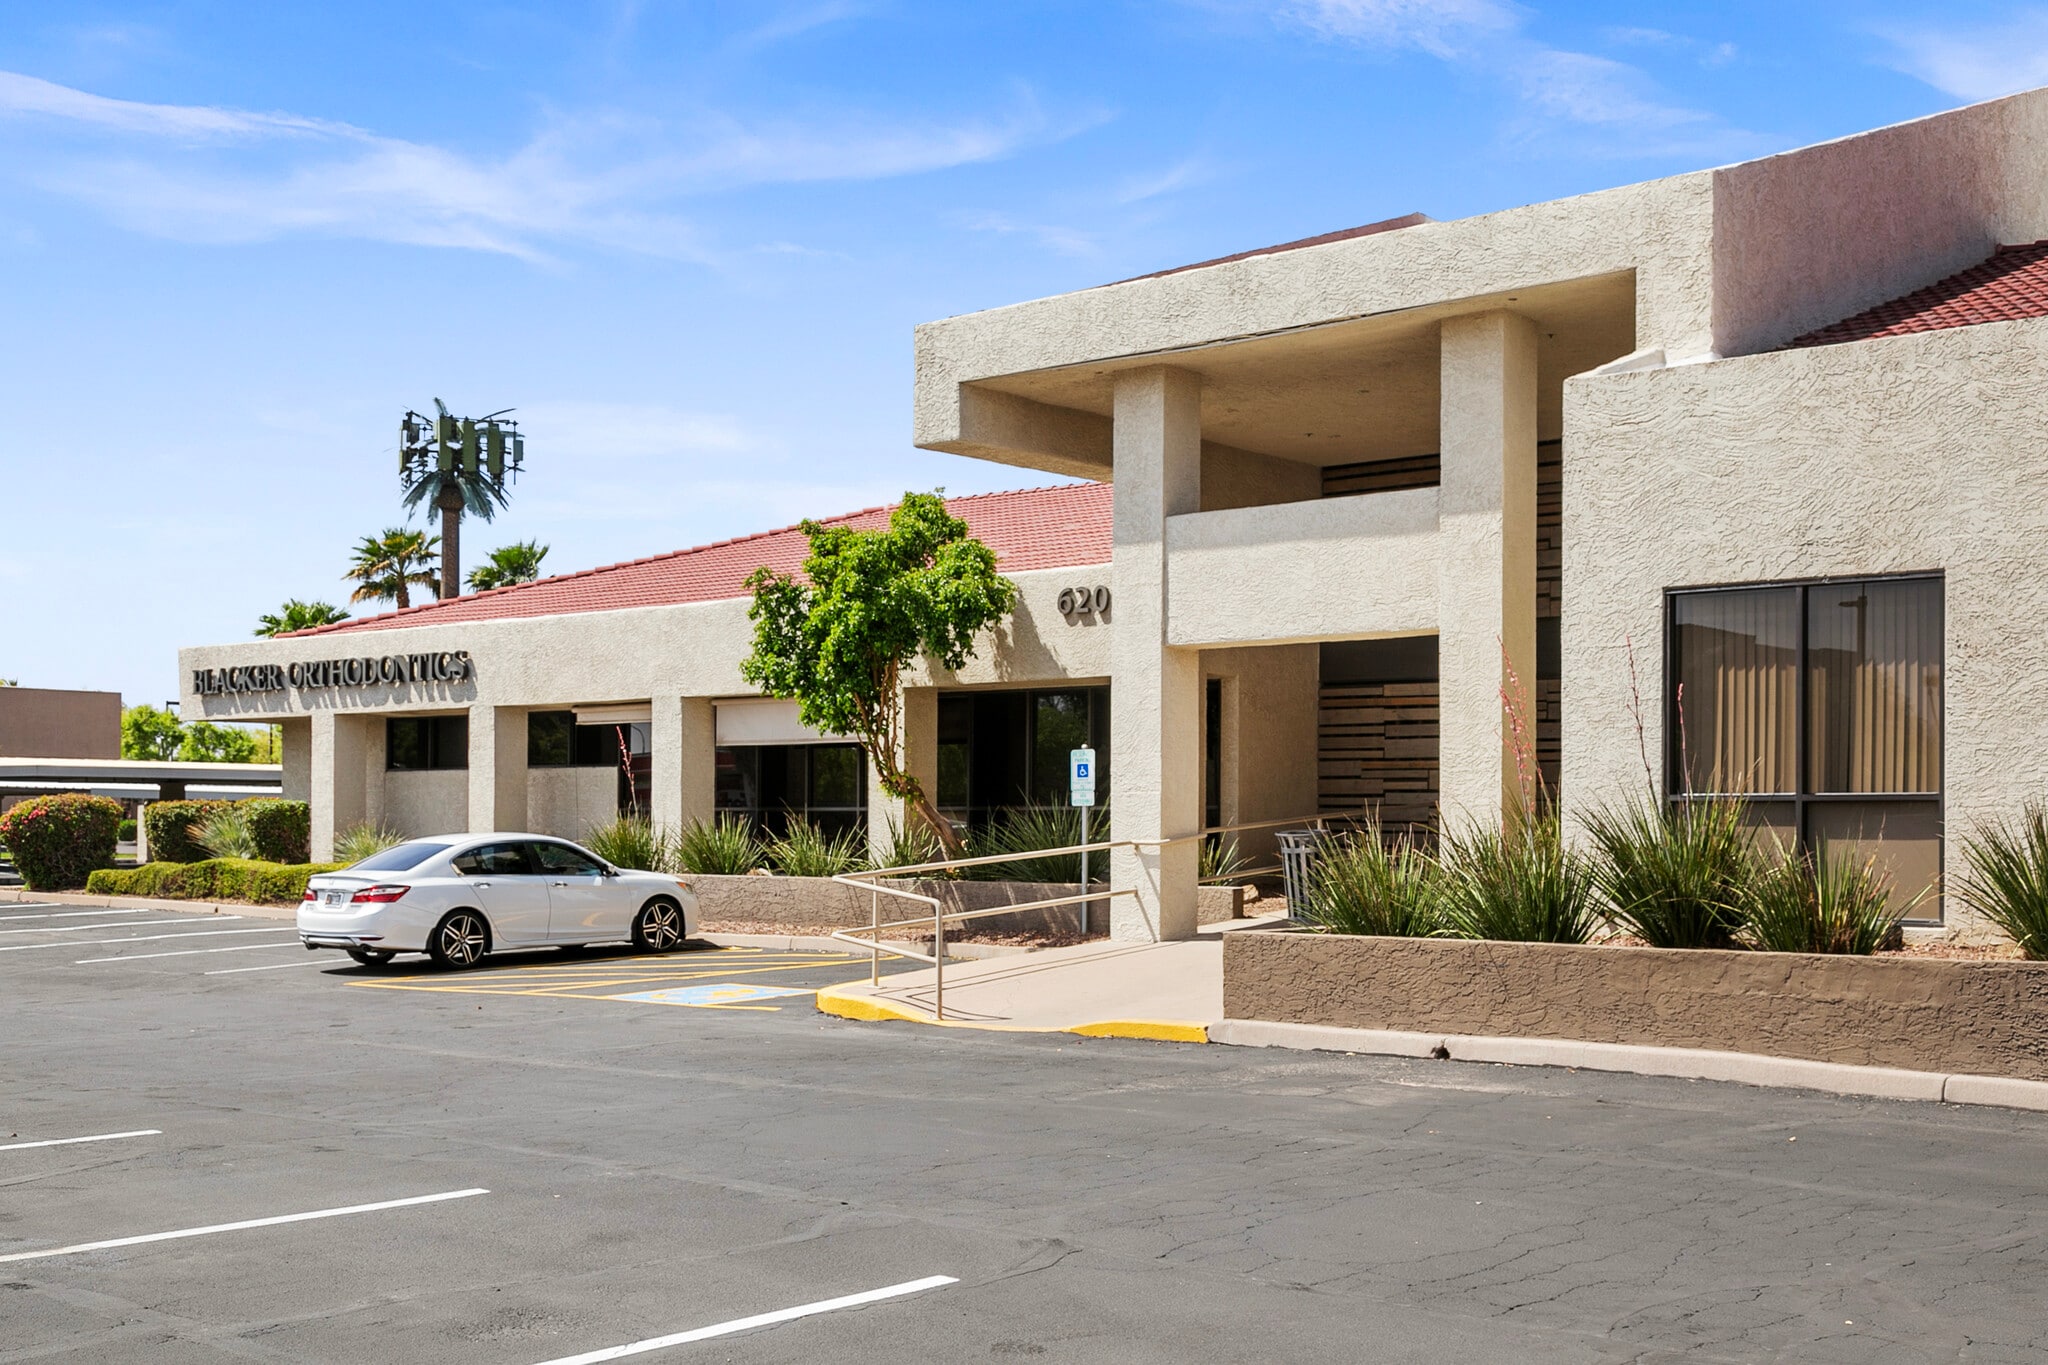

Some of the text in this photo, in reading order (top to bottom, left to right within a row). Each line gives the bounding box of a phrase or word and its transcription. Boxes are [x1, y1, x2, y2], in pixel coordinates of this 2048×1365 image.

[1057, 585, 1111, 616] 620
[192, 650, 470, 696] BLACKER ORTHODONTICS
